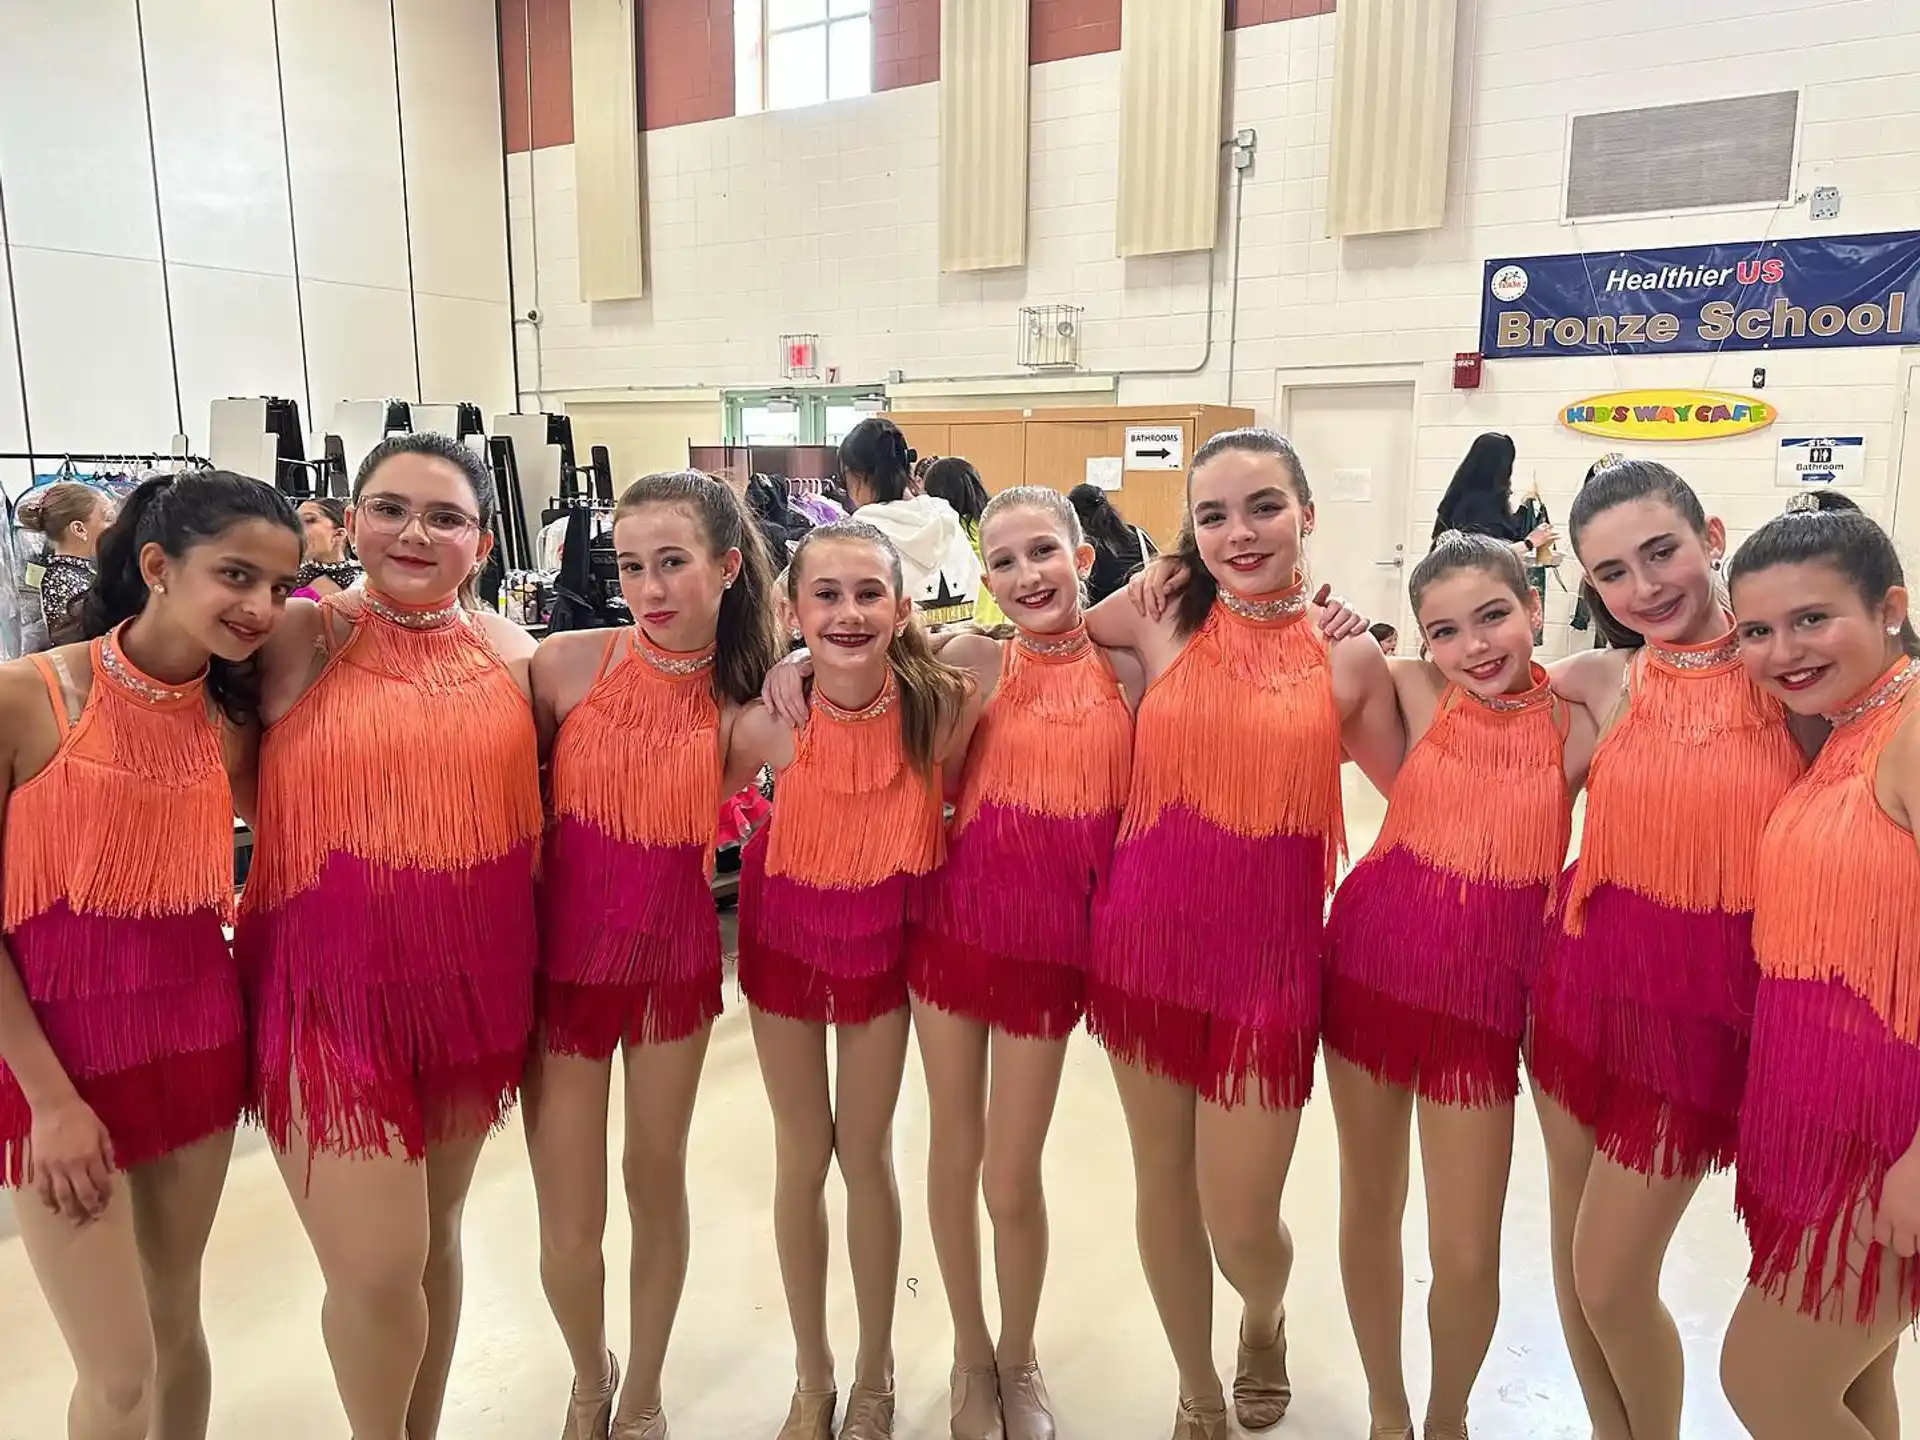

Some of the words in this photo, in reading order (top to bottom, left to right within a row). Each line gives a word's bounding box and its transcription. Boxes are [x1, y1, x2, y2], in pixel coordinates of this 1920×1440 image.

[1497, 311, 1680, 348] Bronze
[1697, 292, 1906, 340] School
[829, 368, 836, 383] 7
[1566, 405, 1630, 424] KID'S
[1633, 404, 1693, 424] WAY
[1695, 404, 1768, 424] CAFE
[1130, 434, 1179, 443] BATHROOMS
[1796, 463, 1844, 471] Bathroom
